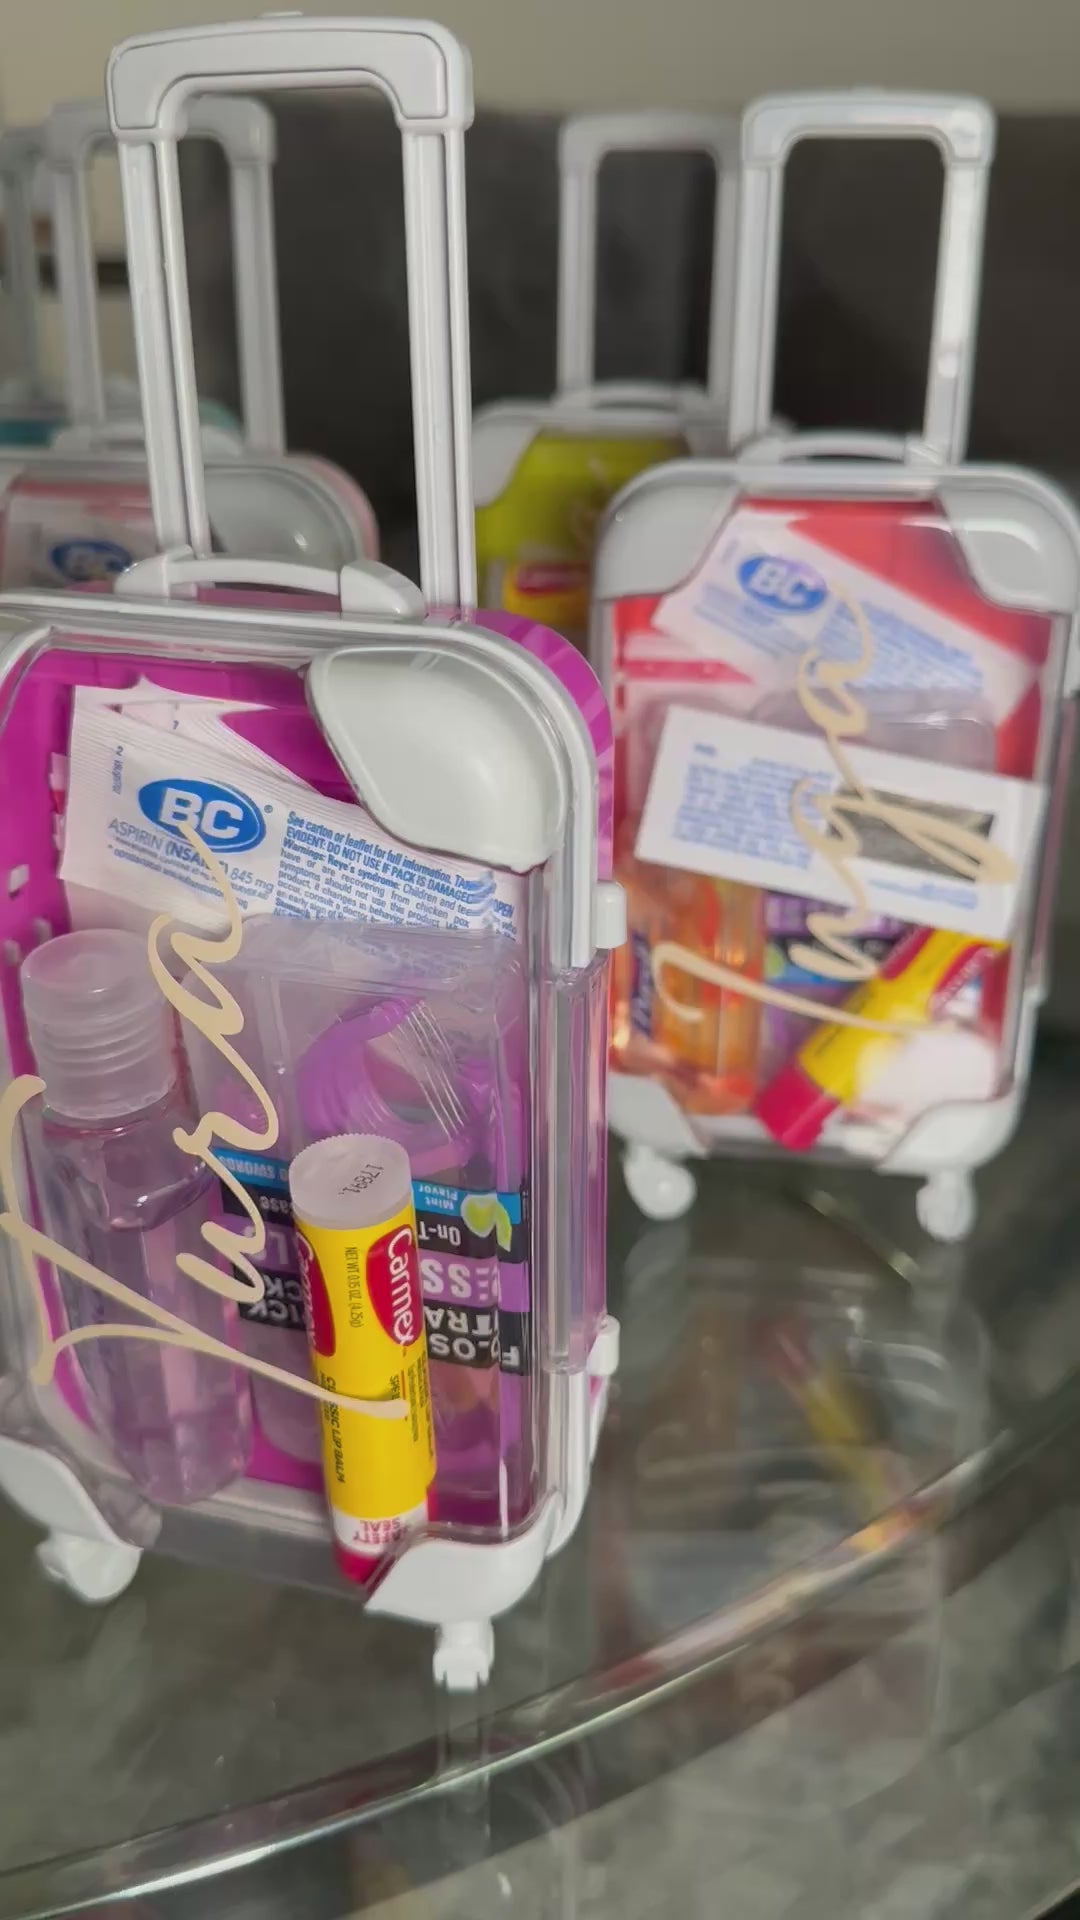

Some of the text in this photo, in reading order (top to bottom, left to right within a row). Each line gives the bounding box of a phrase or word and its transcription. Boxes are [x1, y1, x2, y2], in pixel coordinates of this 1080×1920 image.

[159, 787, 244, 839] BC
[652, 577, 1018, 1030] Inga
[108, 818, 163, 850] ASPIRIN
[231, 867, 253, 884] 845
[255, 878, 275, 894] mg
[305, 821, 333, 838] carton
[334, 833, 345, 842] or
[345, 833, 373, 854] leaflet
[374, 844, 387, 859] for
[387, 850, 403, 866] full
[326, 841, 341, 855] DO
[341, 847, 362, 863] NOT
[363, 855, 382, 871] USE
[382, 862, 392, 874] IF
[391, 866, 416, 884] PACK
[416, 875, 427, 887] IS
[281, 848, 301, 863] have
[306, 860, 316, 868] or
[322, 866, 336, 877] are
[341, 874, 385, 898] recovering
[391, 891, 410, 905] from
[416, 901, 448, 919] chicken
[324, 877, 352, 894] should
[355, 889, 368, 899] not
[372, 896, 386, 908] use
[327, 853, 355, 873] Reye's
[403, 883, 438, 902] Children
[439, 897, 457, 911] and
[419, 1183, 458, 1200] Flavor
[425, 1196, 455, 1211] Mint
[345, 1246, 357, 1259] NET
[346, 1260, 359, 1274] WT
[388, 1227, 415, 1346] Carmex
[325, 1376, 341, 1428] CLSSIC
[331, 1429, 343, 1450] LIP
[333, 1450, 346, 1484] BALM
[360, 1518, 401, 1532] SEAL
